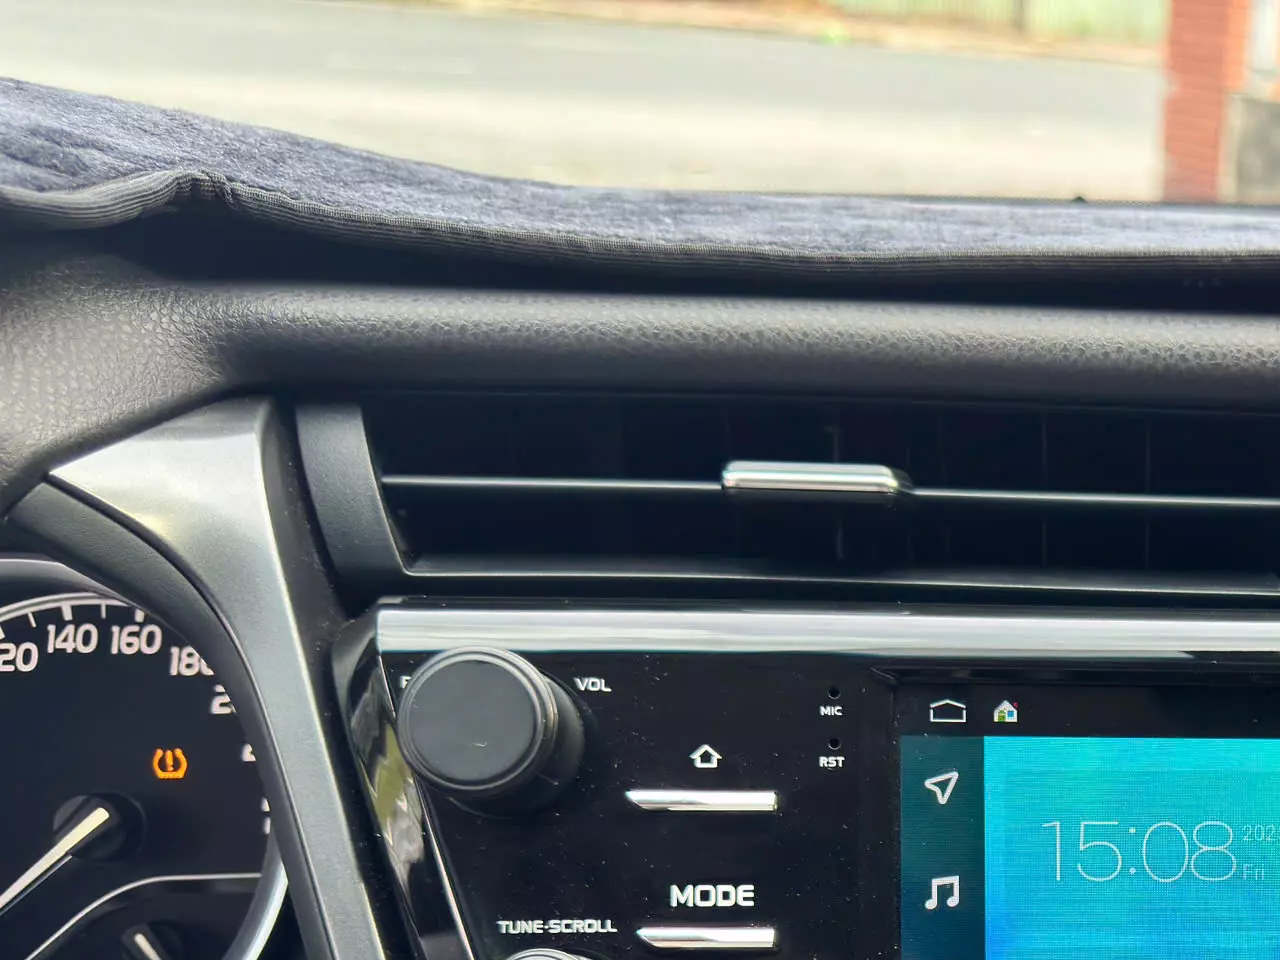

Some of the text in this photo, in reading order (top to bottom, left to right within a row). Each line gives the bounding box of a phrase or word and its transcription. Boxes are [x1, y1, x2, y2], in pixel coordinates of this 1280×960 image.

[47, 624, 98, 653] 140
[110, 625, 162, 655] 160
[0, 642, 39, 672] 20
[574, 677, 612, 692] VOL
[819, 705, 843, 716] MIC
[818, 756, 845, 768] RST
[1041, 821, 1237, 883] 15:08
[1242, 864, 1265, 880] Fri
[669, 884, 755, 907] MODE
